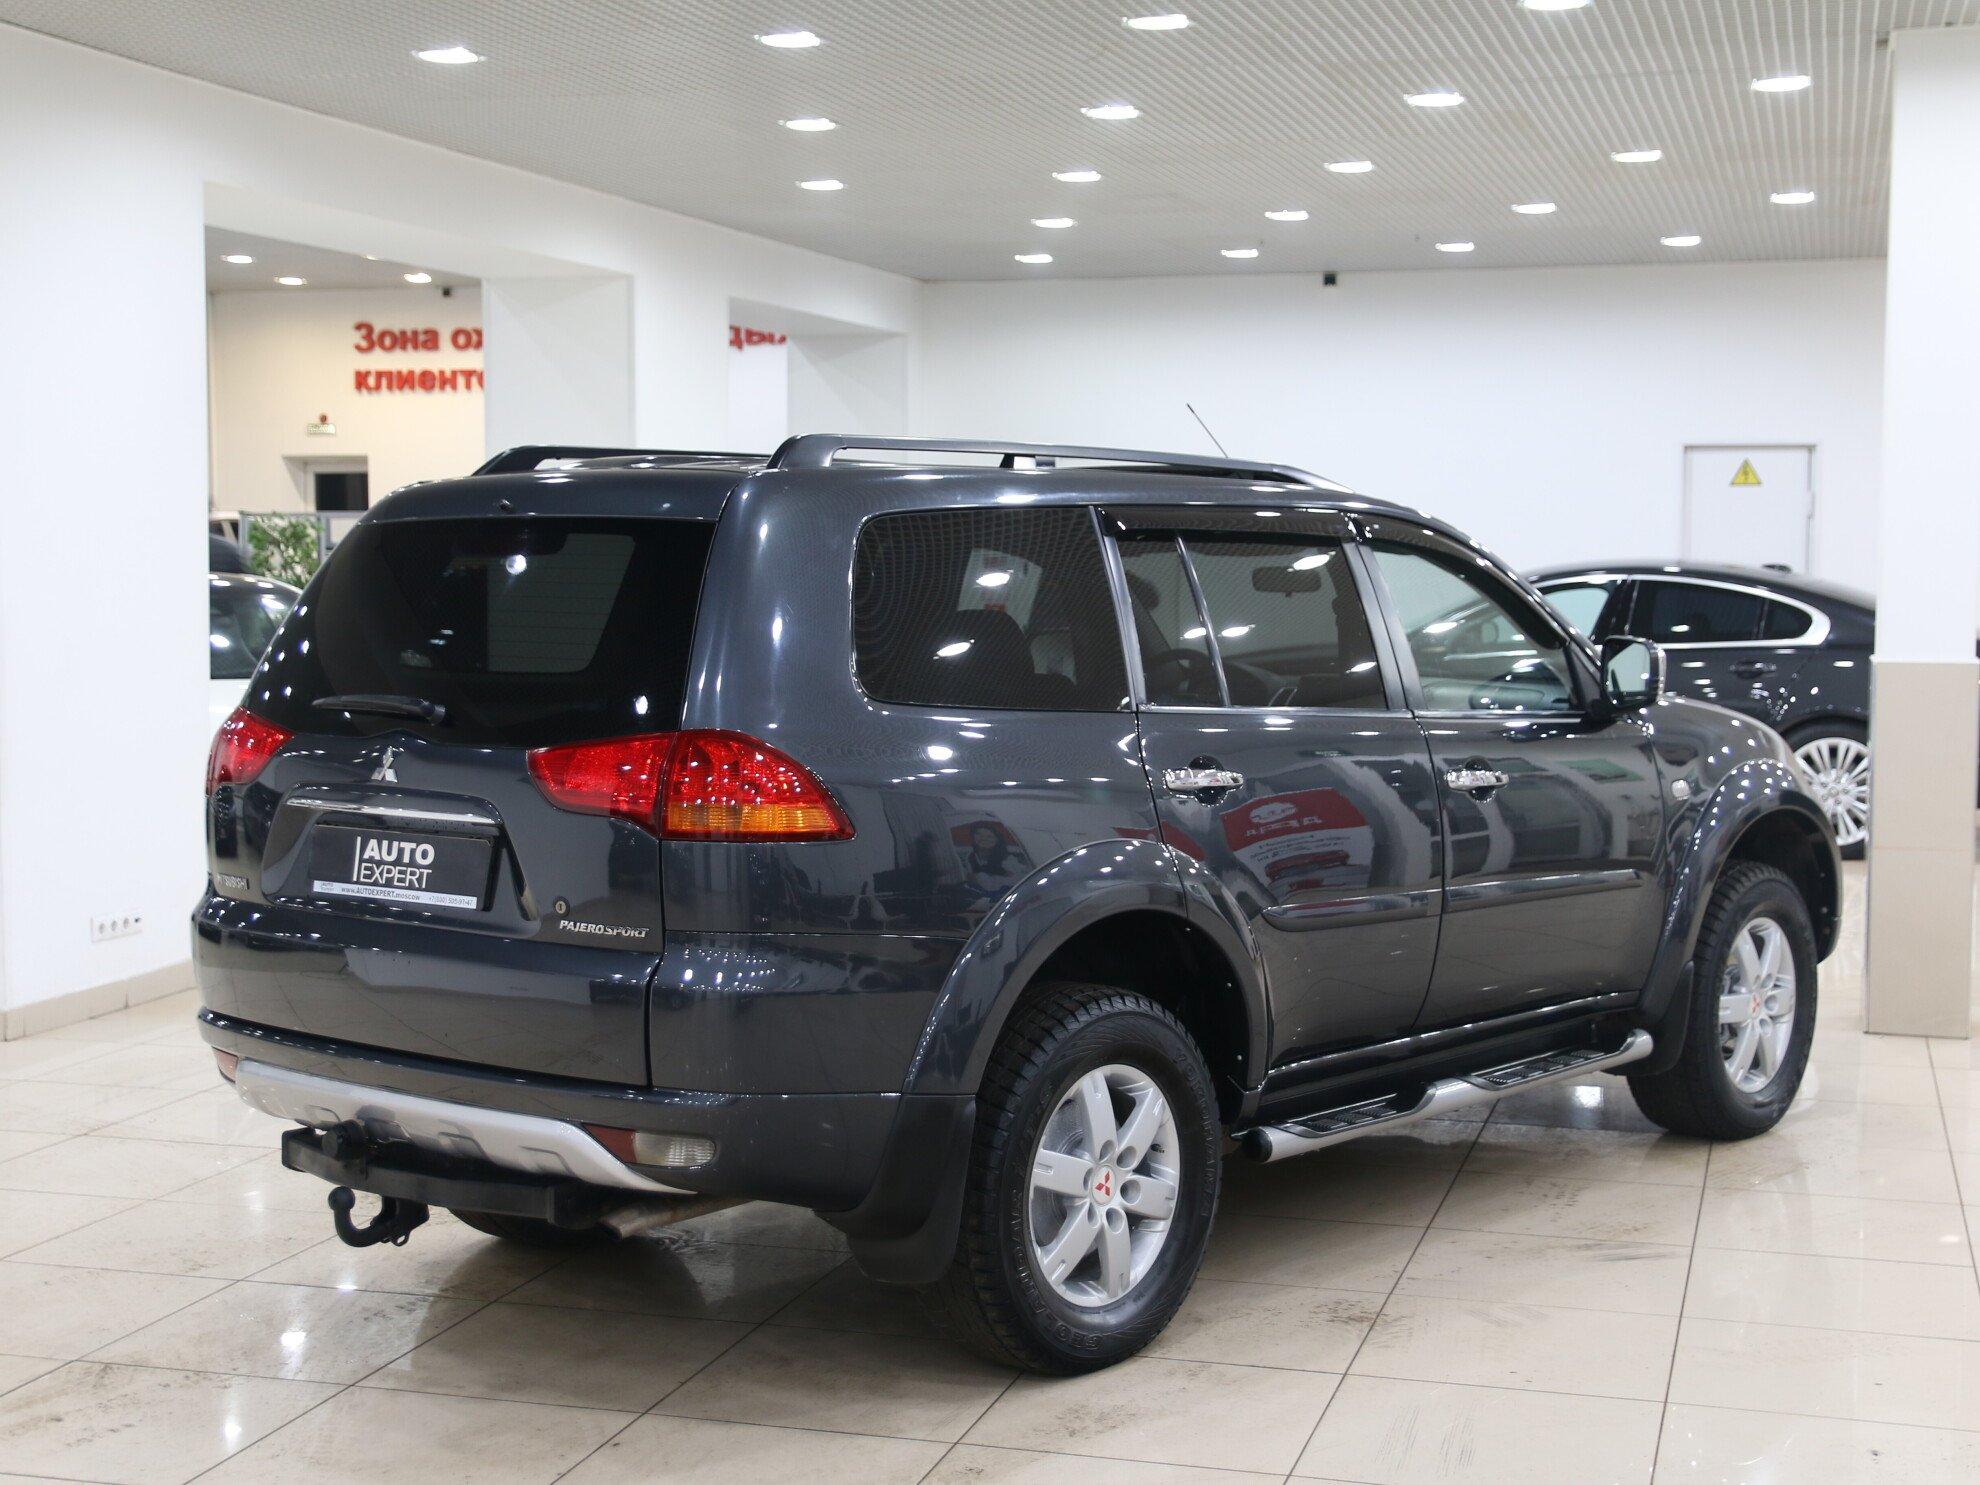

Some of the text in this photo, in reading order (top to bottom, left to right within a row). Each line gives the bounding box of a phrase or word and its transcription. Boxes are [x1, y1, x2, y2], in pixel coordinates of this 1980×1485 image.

[354, 322, 440, 353] Зона
[354, 369, 484, 393] клиент
[363, 838, 435, 866] AUTO
[360, 862, 432, 889] EXPERT
[559, 919, 605, 934] PAJERO
